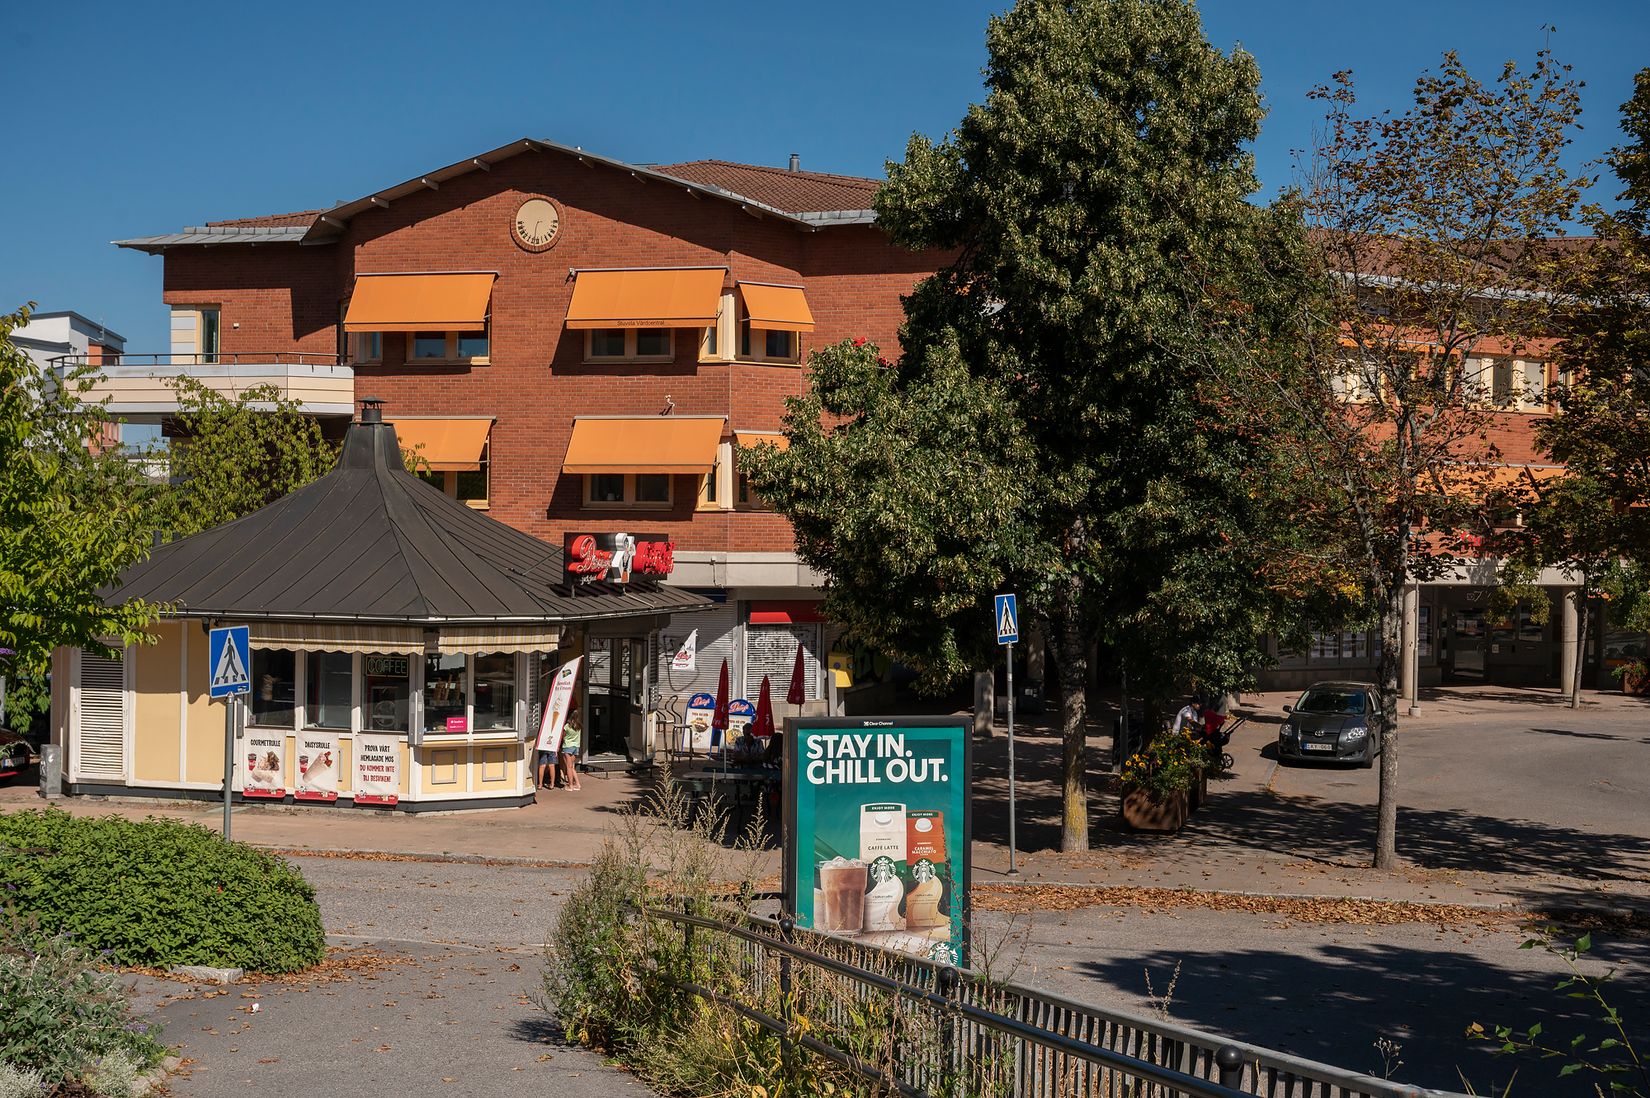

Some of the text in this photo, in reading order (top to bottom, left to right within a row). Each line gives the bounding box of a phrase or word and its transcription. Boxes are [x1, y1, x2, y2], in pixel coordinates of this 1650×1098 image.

[367, 659, 407, 673] COFFEE
[250, 739, 281, 747] GOURMETRULLE
[304, 741, 330, 749] DAISYSRULLE
[806, 733, 913, 759] STAY IN.
[364, 744, 379, 752] PROVA
[360, 755, 384, 763] HEMLAGADE
[806, 758, 949, 785] CHILL OUT.
